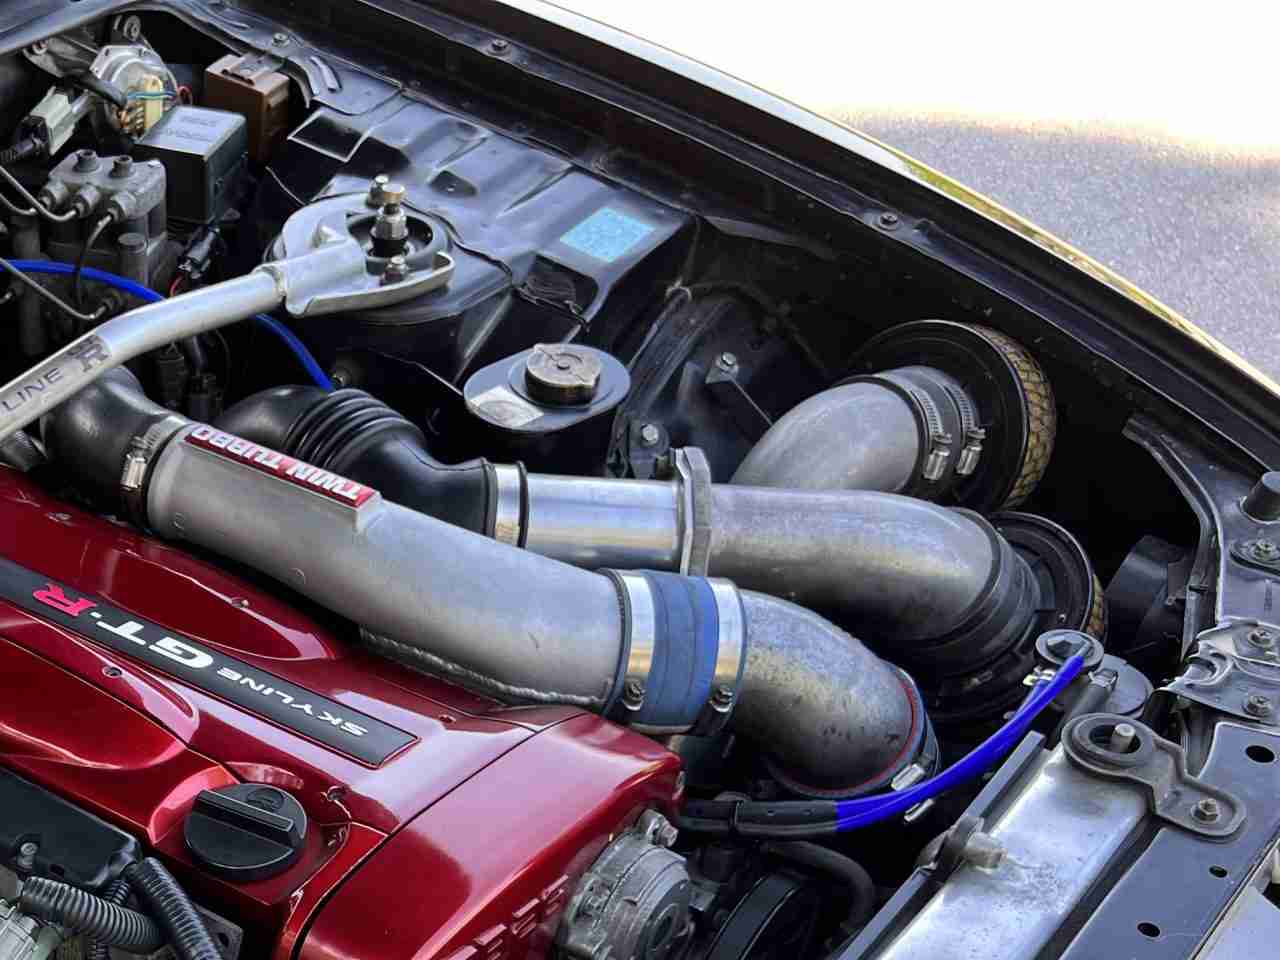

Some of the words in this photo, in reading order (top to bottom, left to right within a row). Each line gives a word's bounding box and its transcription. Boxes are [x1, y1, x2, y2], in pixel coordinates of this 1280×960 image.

[191, 424, 284, 471] TURBO
[286, 458, 363, 500] TWIN
[32, 583, 214, 669] GT-R
[216, 665, 368, 737] SKYLINE
